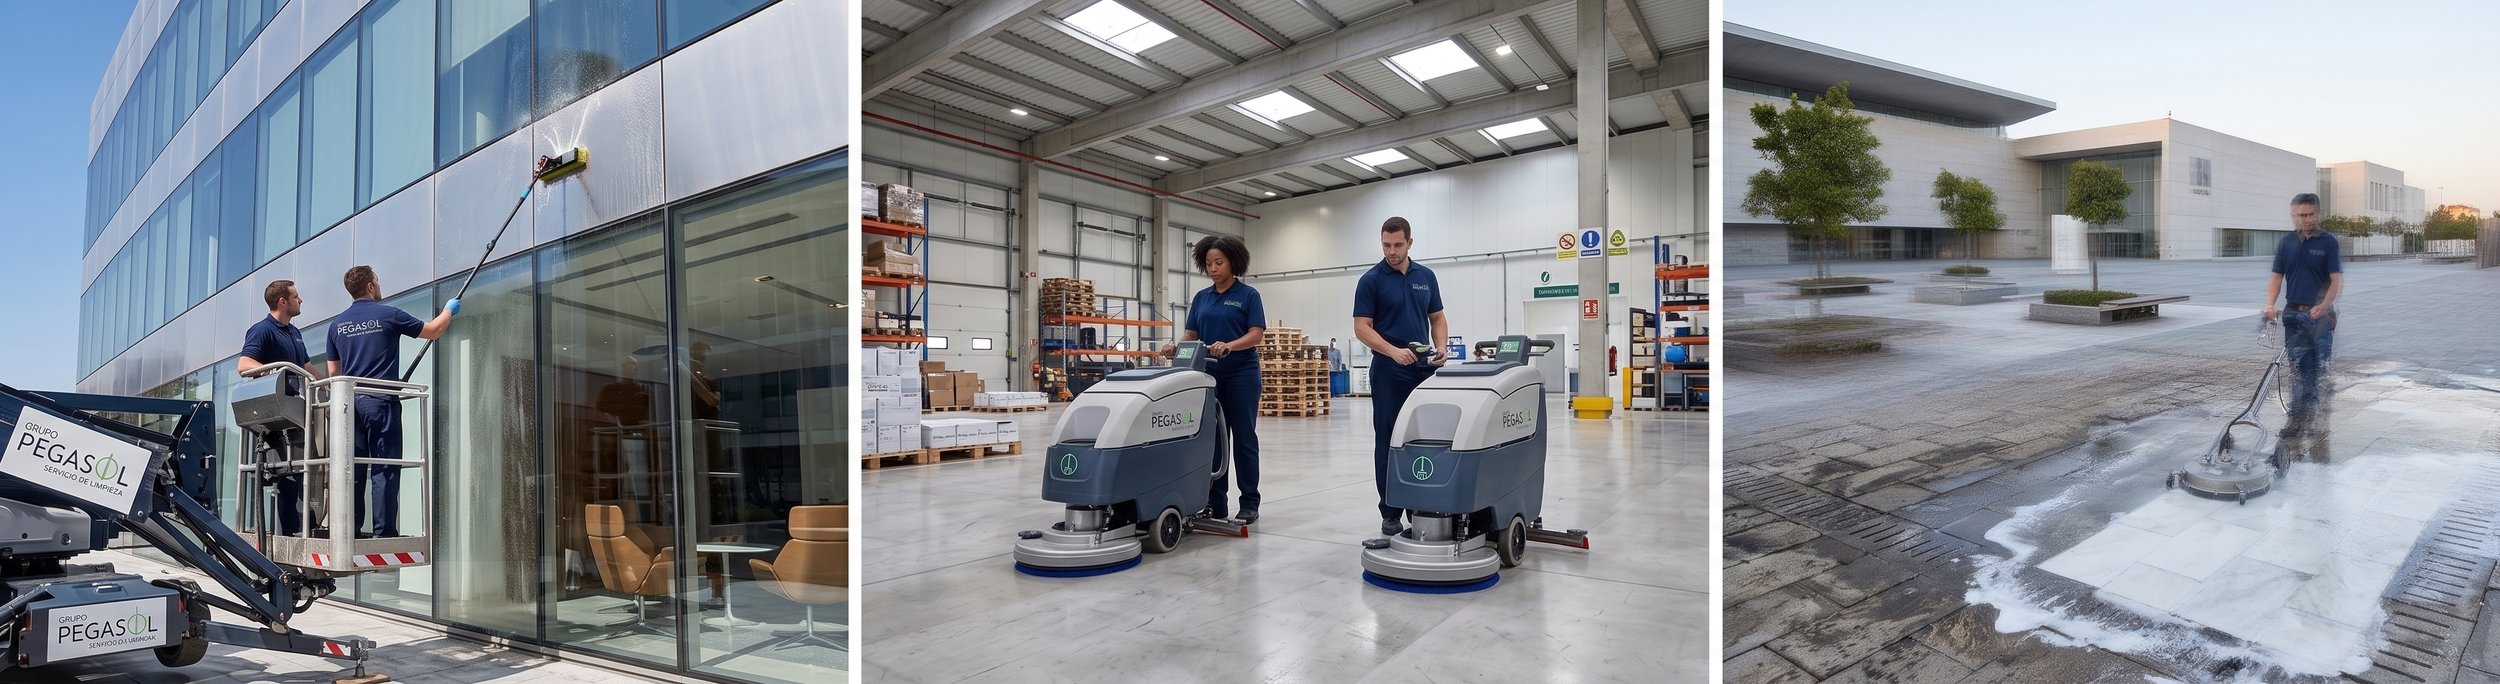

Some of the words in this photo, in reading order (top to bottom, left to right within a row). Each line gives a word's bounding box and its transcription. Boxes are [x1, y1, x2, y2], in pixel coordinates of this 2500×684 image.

[338, 320, 382, 335] PEGASOL
[25, 422, 58, 439] GRUPO
[17, 432, 128, 487] PEGASOL
[44, 464, 77, 481] SERVICIO
[79, 477, 88, 486] DE
[90, 480, 123, 496] LIMPIEZA
[59, 614, 87, 624] GRUPO
[59, 607, 157, 644] PEGASOL
